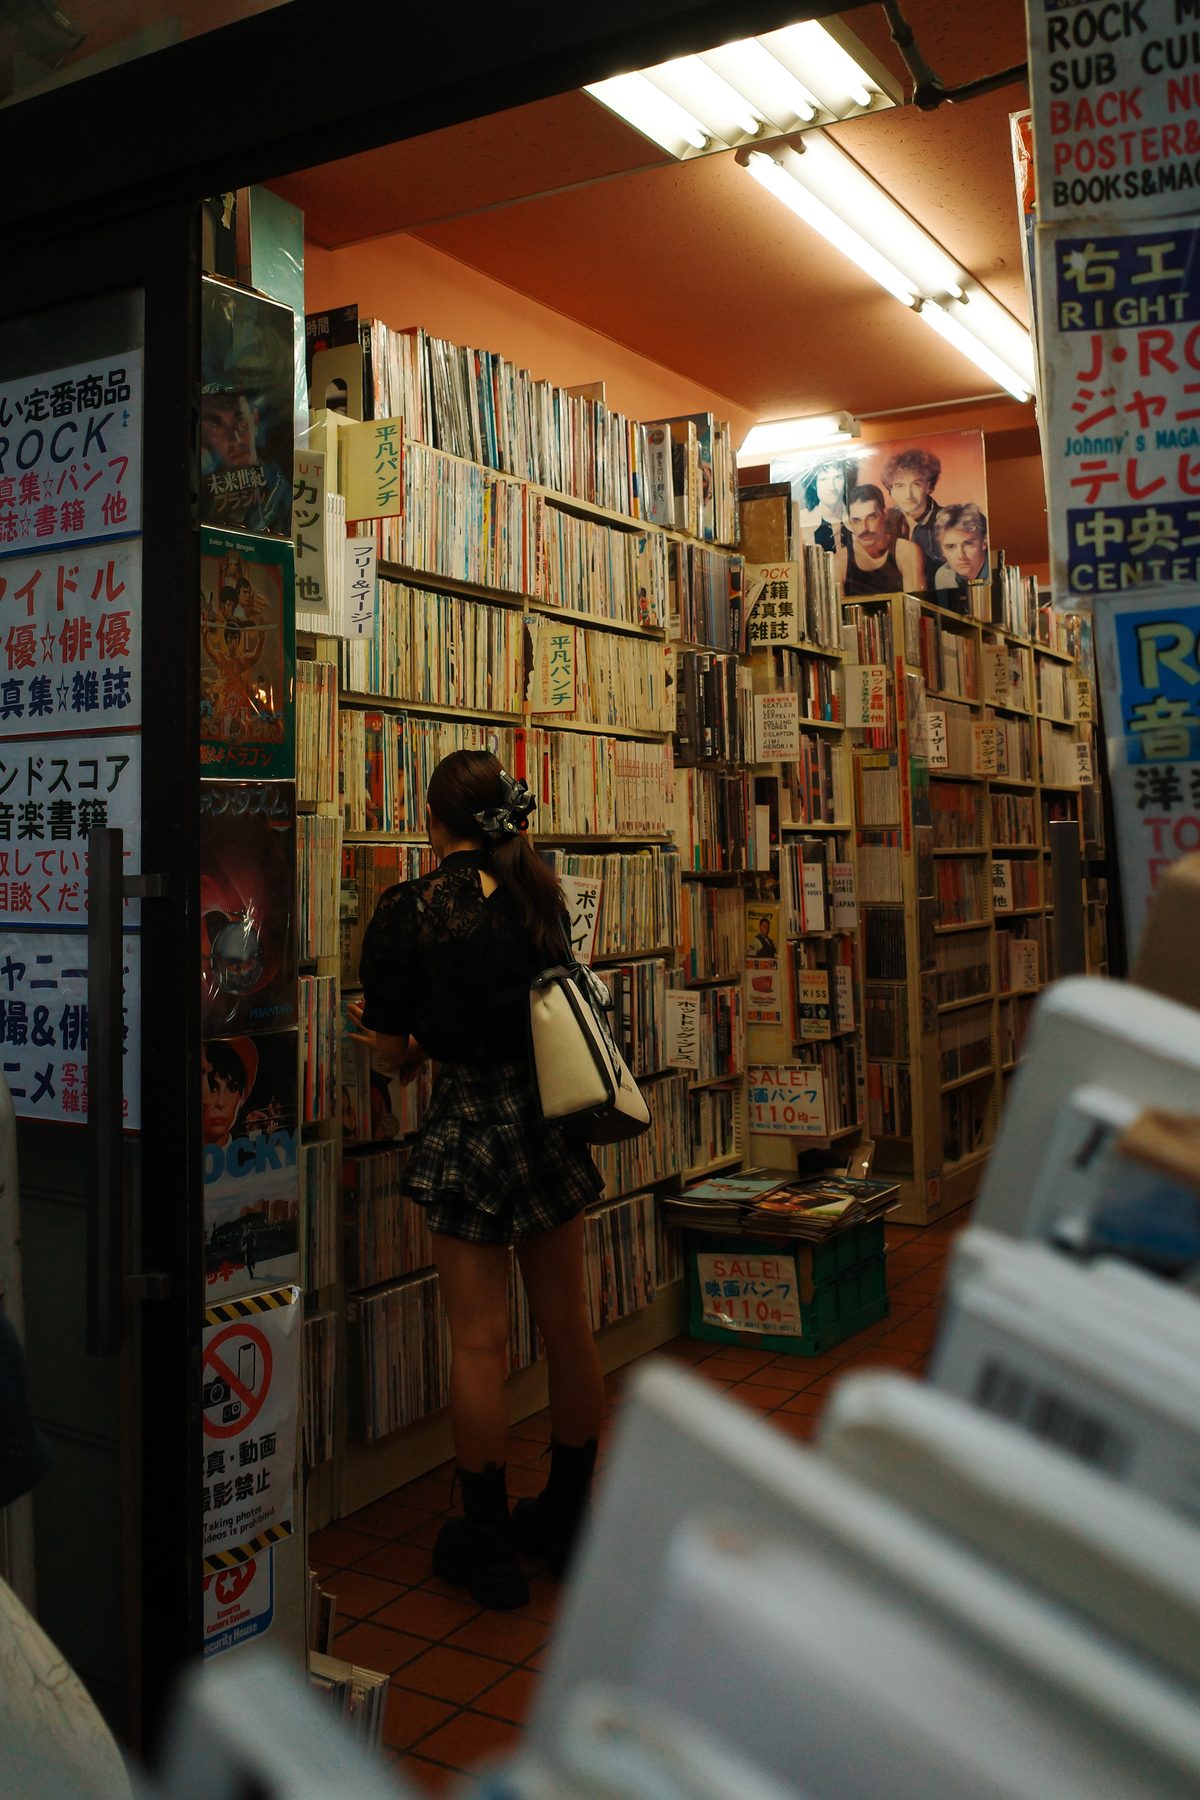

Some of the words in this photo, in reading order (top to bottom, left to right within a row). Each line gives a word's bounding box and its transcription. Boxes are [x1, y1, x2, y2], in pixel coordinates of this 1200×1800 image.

[1047, 1, 1148, 52] ROCK
[1049, 52, 1117, 94] SUB
[1049, 86, 1143, 135] BACK
[1167, 71, 1200, 114] N
[1061, 292, 1190, 329] RIGHT
[374, 424, 399, 507] 平凡パンチ
[1070, 556, 1200, 593] CENTE
[551, 635, 572, 706] 平凡パンチ
[1134, 764, 1200, 812] 洋
[571, 889, 597, 951] ポパイ
[802, 989, 827, 998] KISS
[748, 1070, 809, 1087] SALE!
[705, 1279, 791, 1298] 映画パンフ
[713, 1260, 781, 1280] SALE!
[201, 1432, 276, 1481] 真・動画
[233, 1622, 258, 1641] House
